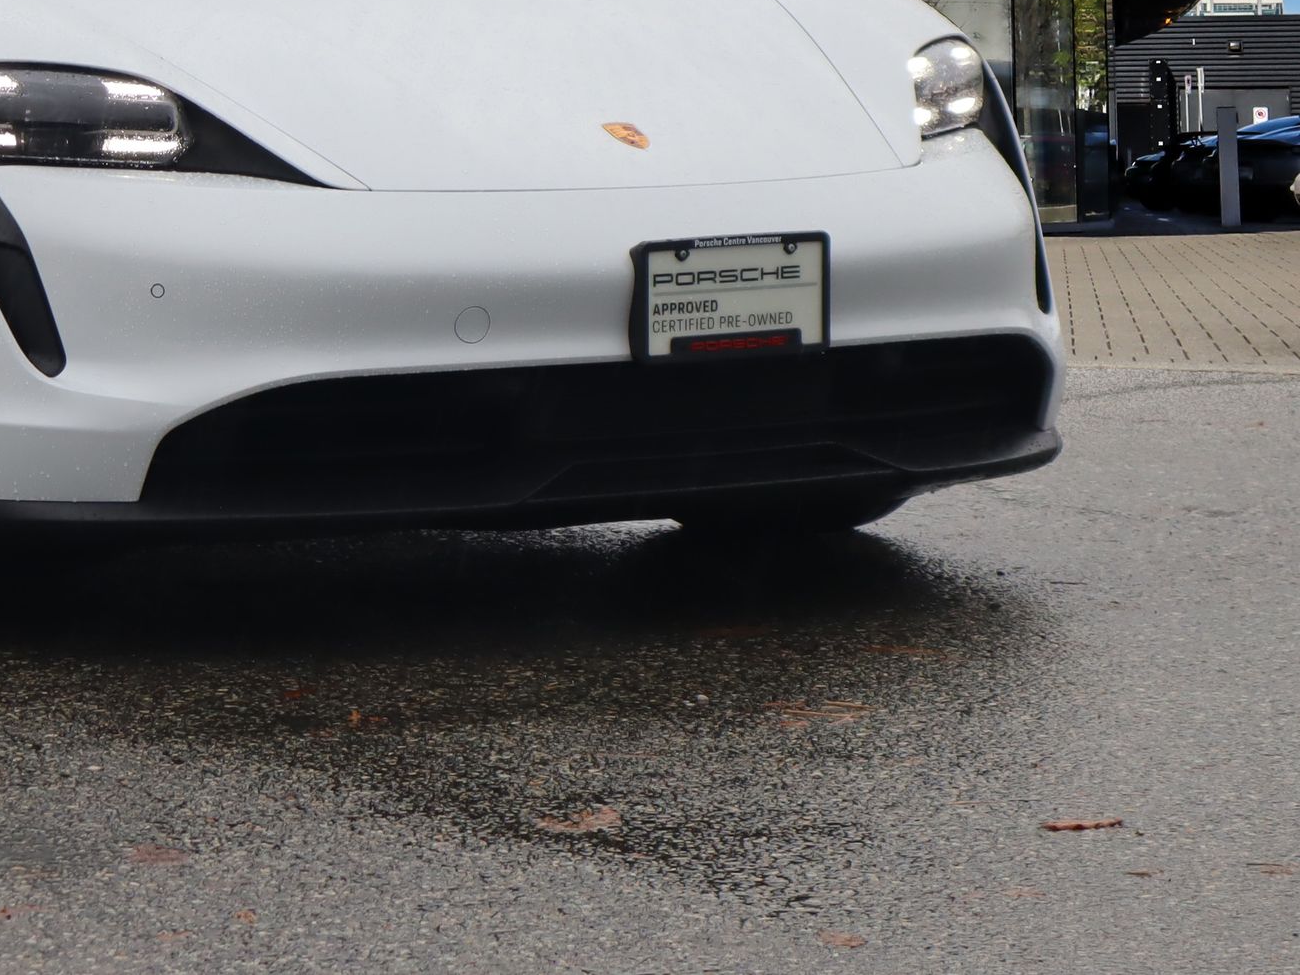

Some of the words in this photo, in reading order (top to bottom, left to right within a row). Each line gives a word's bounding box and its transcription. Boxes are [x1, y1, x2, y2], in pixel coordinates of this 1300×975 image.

[694, 238, 722, 248] Porsche
[723, 236, 746, 246] Centre
[747, 235, 782, 244] Vancouver
[653, 265, 801, 287] PORSCHE
[653, 300, 719, 316] APPROVED
[652, 316, 715, 334] CERTIFIED
[719, 311, 793, 329] PRE-OWNED
[691, 336, 787, 351] PORSCHE
